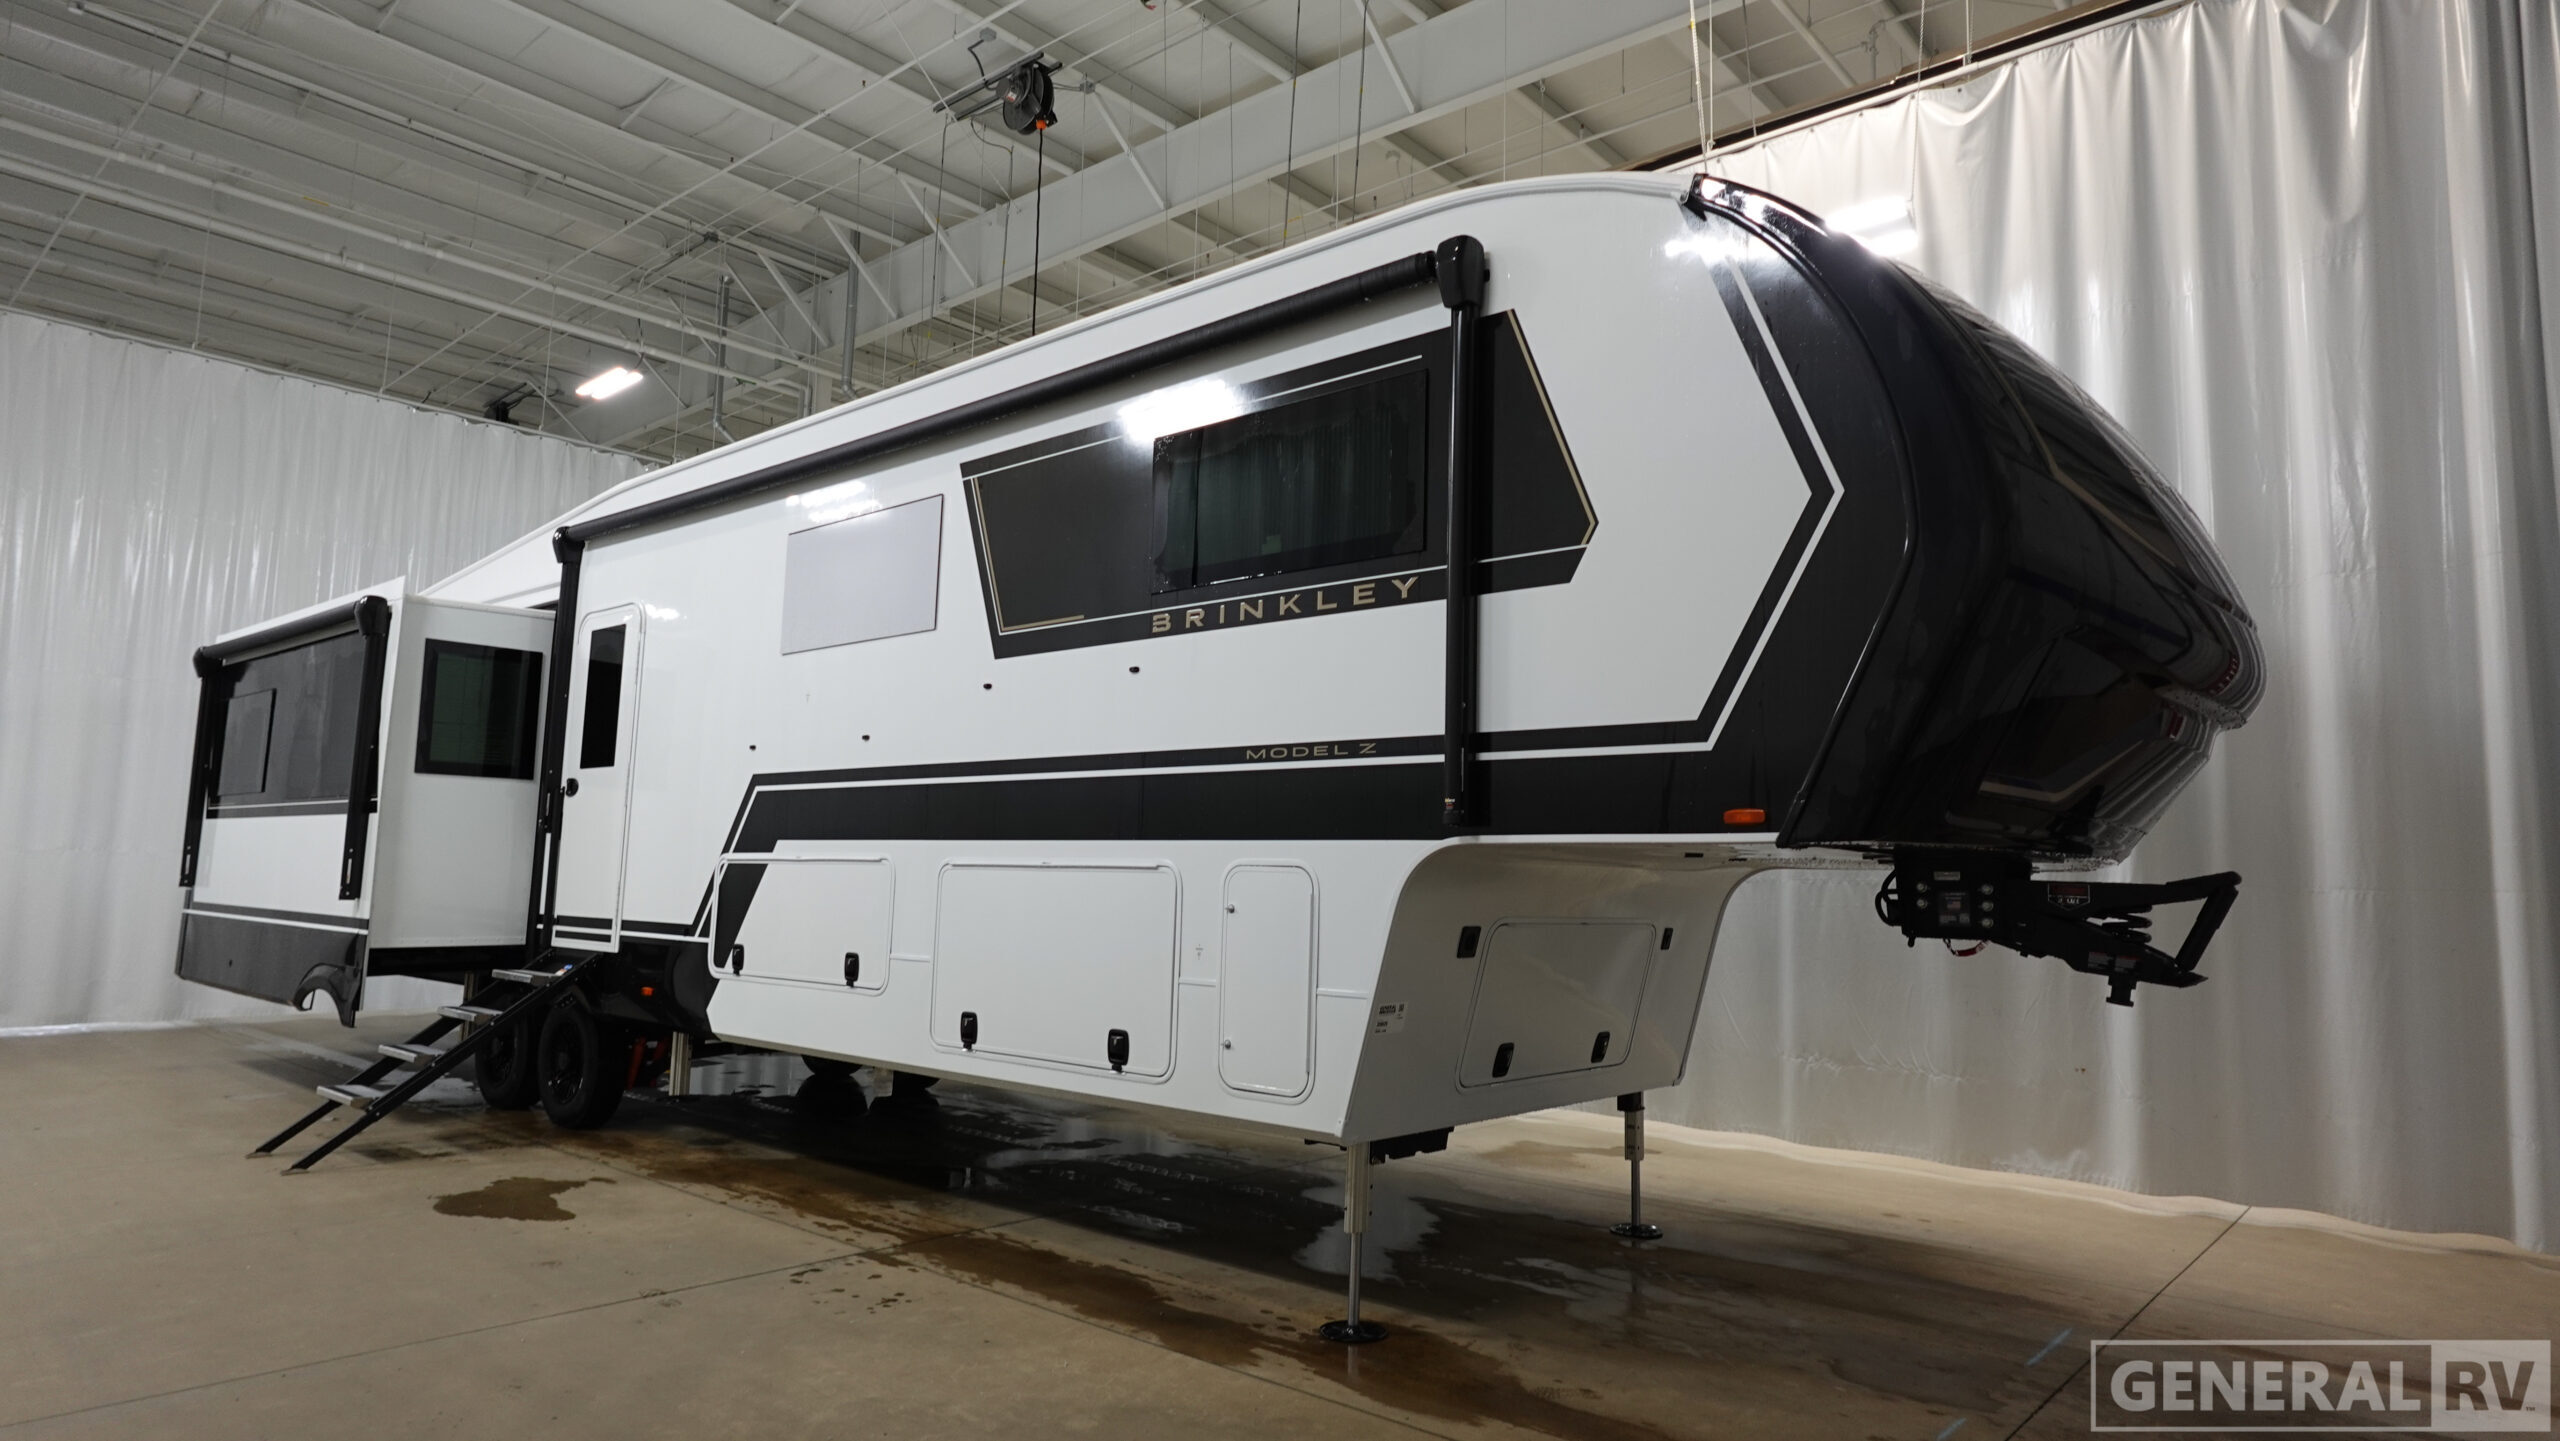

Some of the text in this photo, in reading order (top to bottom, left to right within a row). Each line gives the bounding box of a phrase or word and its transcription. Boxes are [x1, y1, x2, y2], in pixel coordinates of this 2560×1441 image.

[1151, 576, 1419, 633] BRINKLEY
[1246, 742, 1377, 760] MODEL Z
